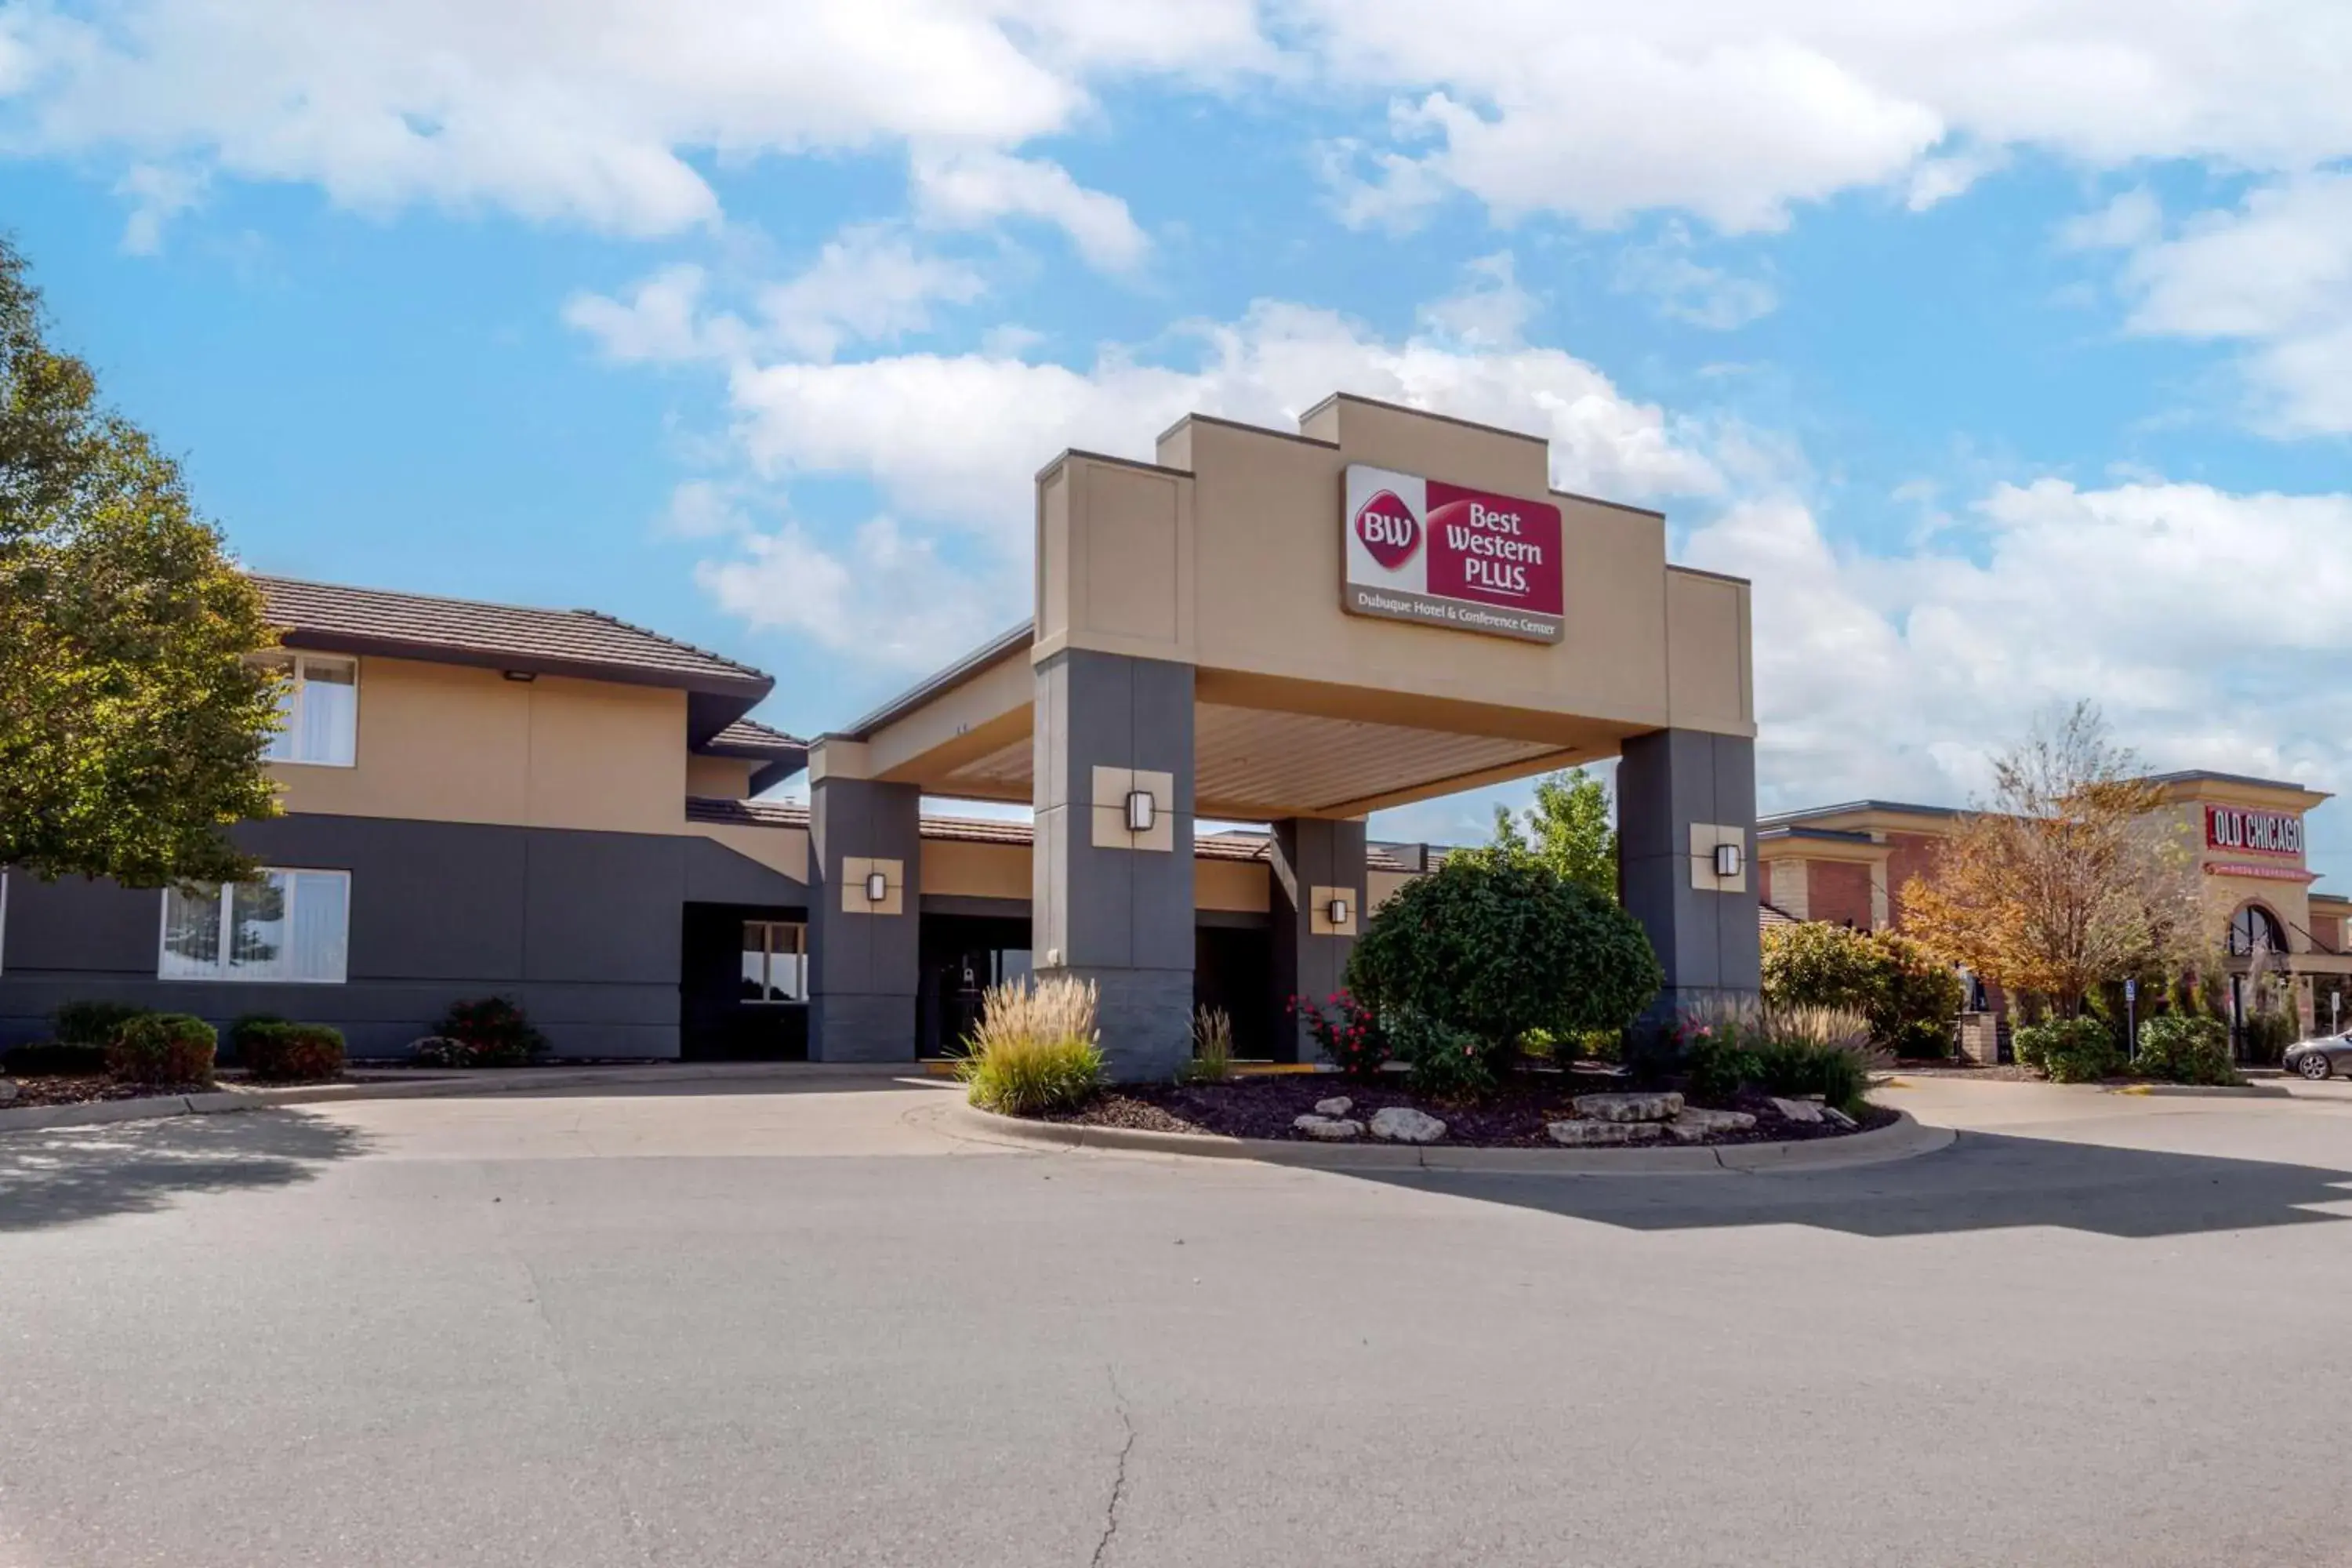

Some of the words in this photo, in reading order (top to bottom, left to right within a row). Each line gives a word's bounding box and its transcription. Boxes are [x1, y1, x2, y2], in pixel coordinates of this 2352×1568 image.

[1364, 513, 1410, 547] BW
[1470, 502, 1522, 535] Best
[1446, 524, 1542, 564] Western
[1359, 593, 1411, 612] Dubuque
[1414, 602, 1445, 618] Hotel
[1448, 607, 1456, 619] &
[1458, 609, 1519, 628] Conference
[1520, 619, 1555, 635] Center
[2216, 811, 2241, 846] OLD
[2246, 815, 2302, 852] CHICAGO
